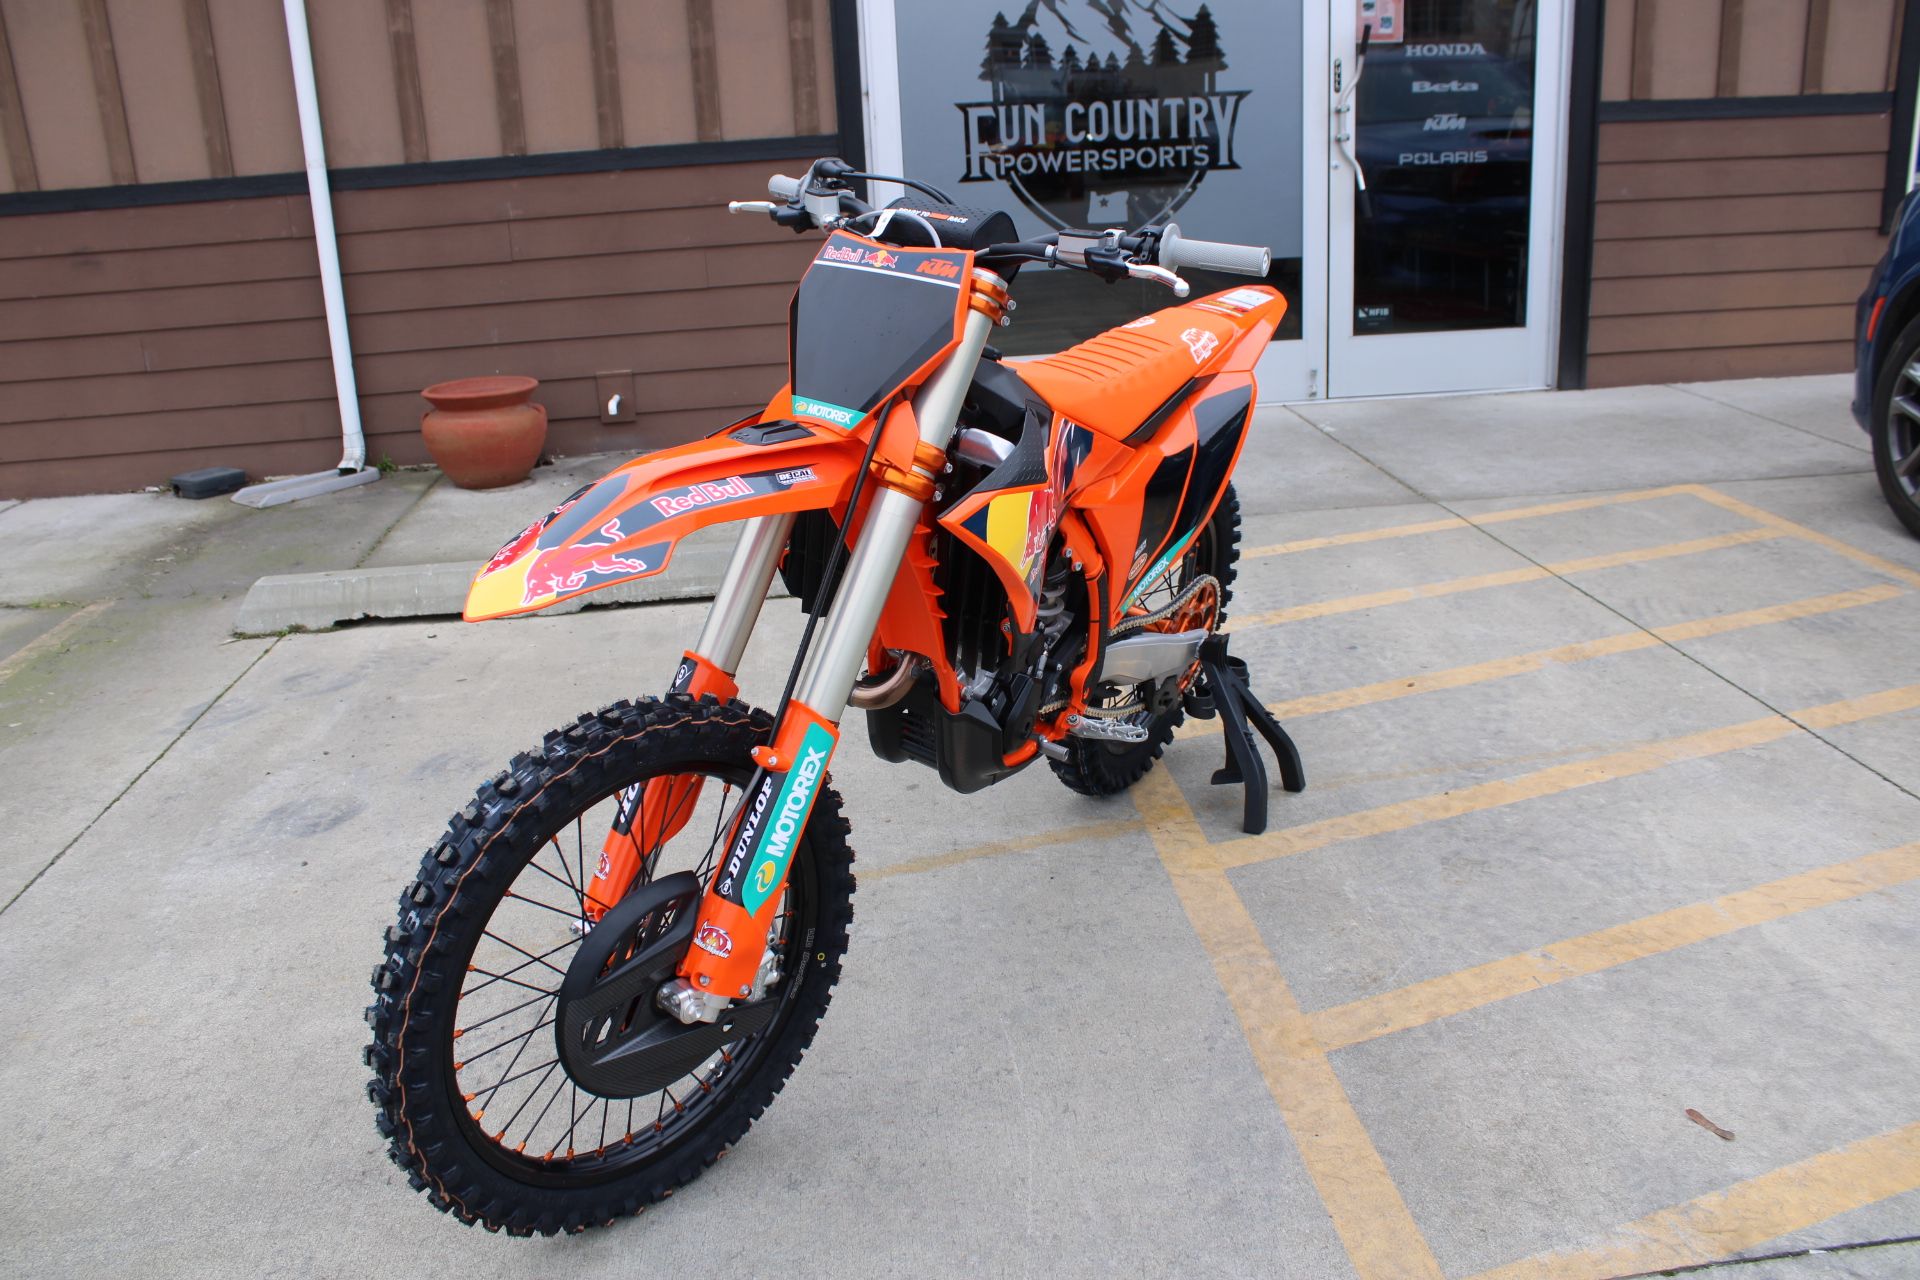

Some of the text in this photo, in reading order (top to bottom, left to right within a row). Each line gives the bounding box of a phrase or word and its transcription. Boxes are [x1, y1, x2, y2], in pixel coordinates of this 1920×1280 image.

[1404, 43, 1487, 57] HONDA
[1412, 80, 1479, 93] Beta
[1423, 113, 1467, 131] KTM
[957, 91, 1252, 182] FUN COUNTRY
[999, 145, 1210, 177] POWERSPORTS
[1399, 150, 1488, 166] POLARIS
[946, 215, 969, 224] RACE
[916, 258, 961, 280] KTM
[807, 402, 855, 425] MOTOREX
[1133, 556, 1170, 599] MOTOREX
[765, 746, 828, 858] MOTOREX
[728, 776, 773, 879] DUNLOP
